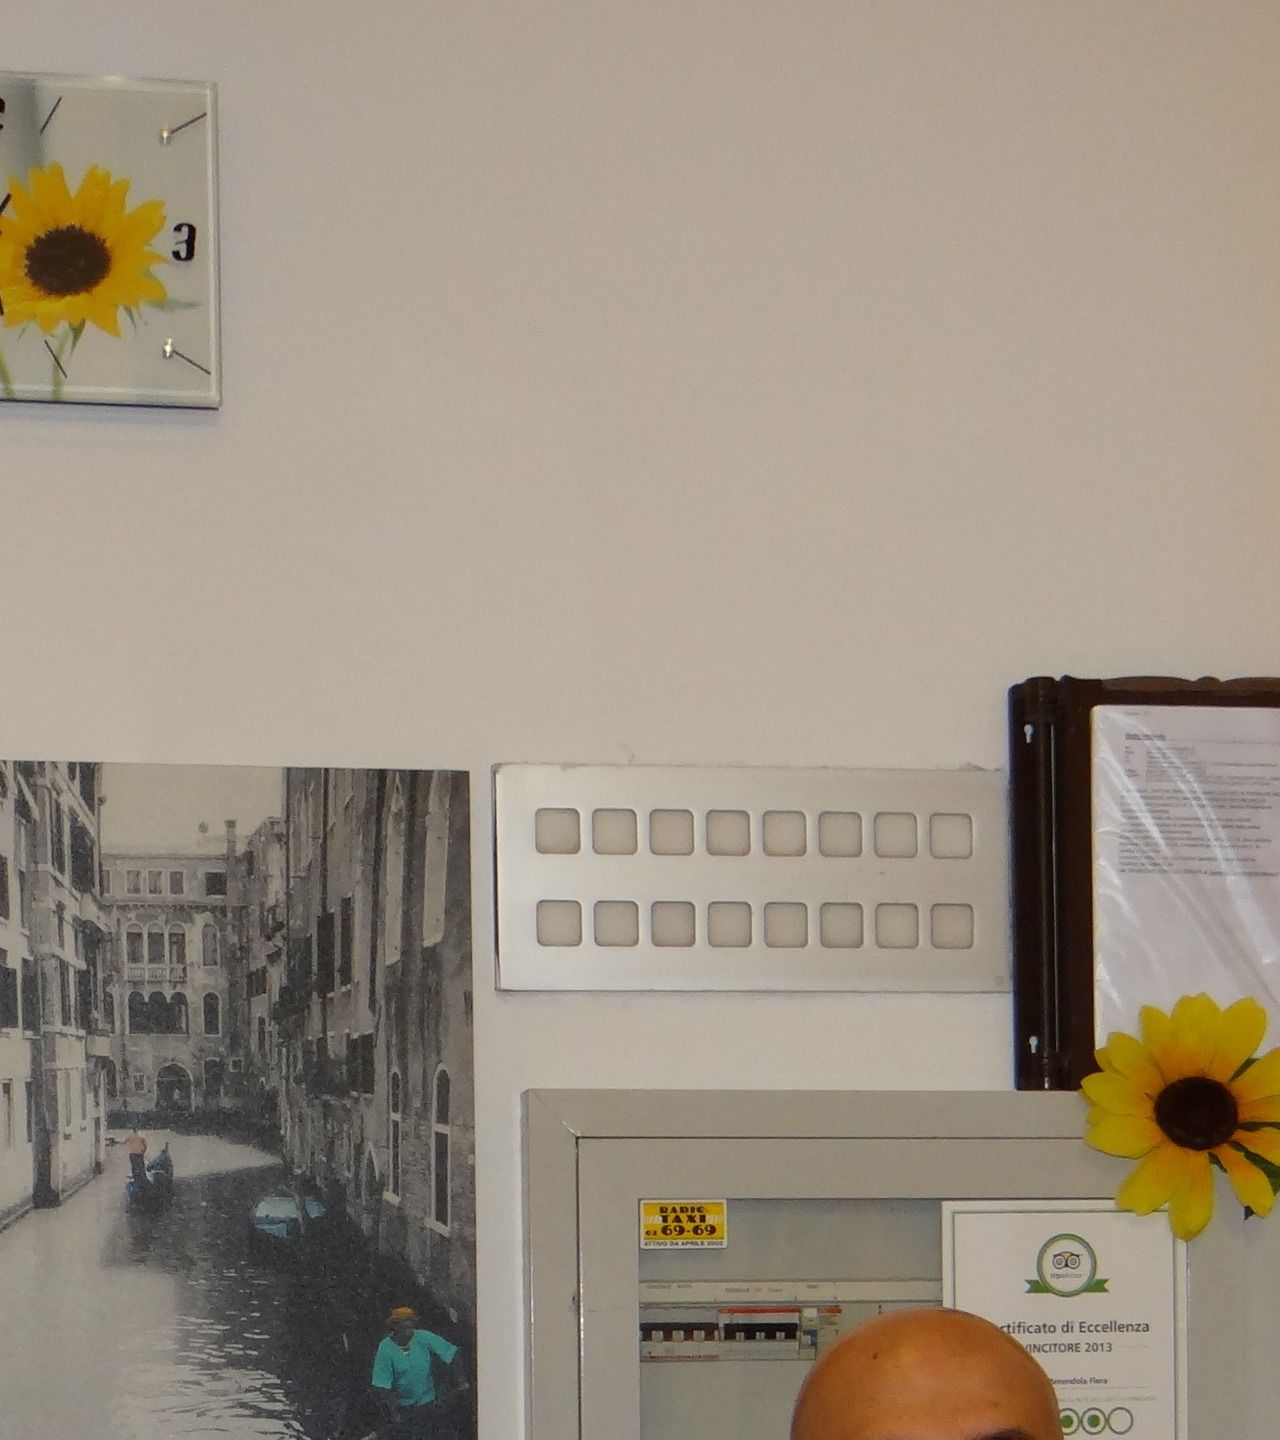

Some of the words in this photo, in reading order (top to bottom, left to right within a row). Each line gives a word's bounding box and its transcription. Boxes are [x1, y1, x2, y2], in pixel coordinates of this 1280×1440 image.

[172, 222, 197, 261] 3
[659, 1206, 705, 1214] RADIO
[661, 1214, 706, 1223] TAXI
[661, 1224, 717, 1236] 69-69
[1061, 1321, 1074, 1334] di
[1079, 1321, 1150, 1334] Eccellenza
[1085, 1342, 1112, 1353] 2013
